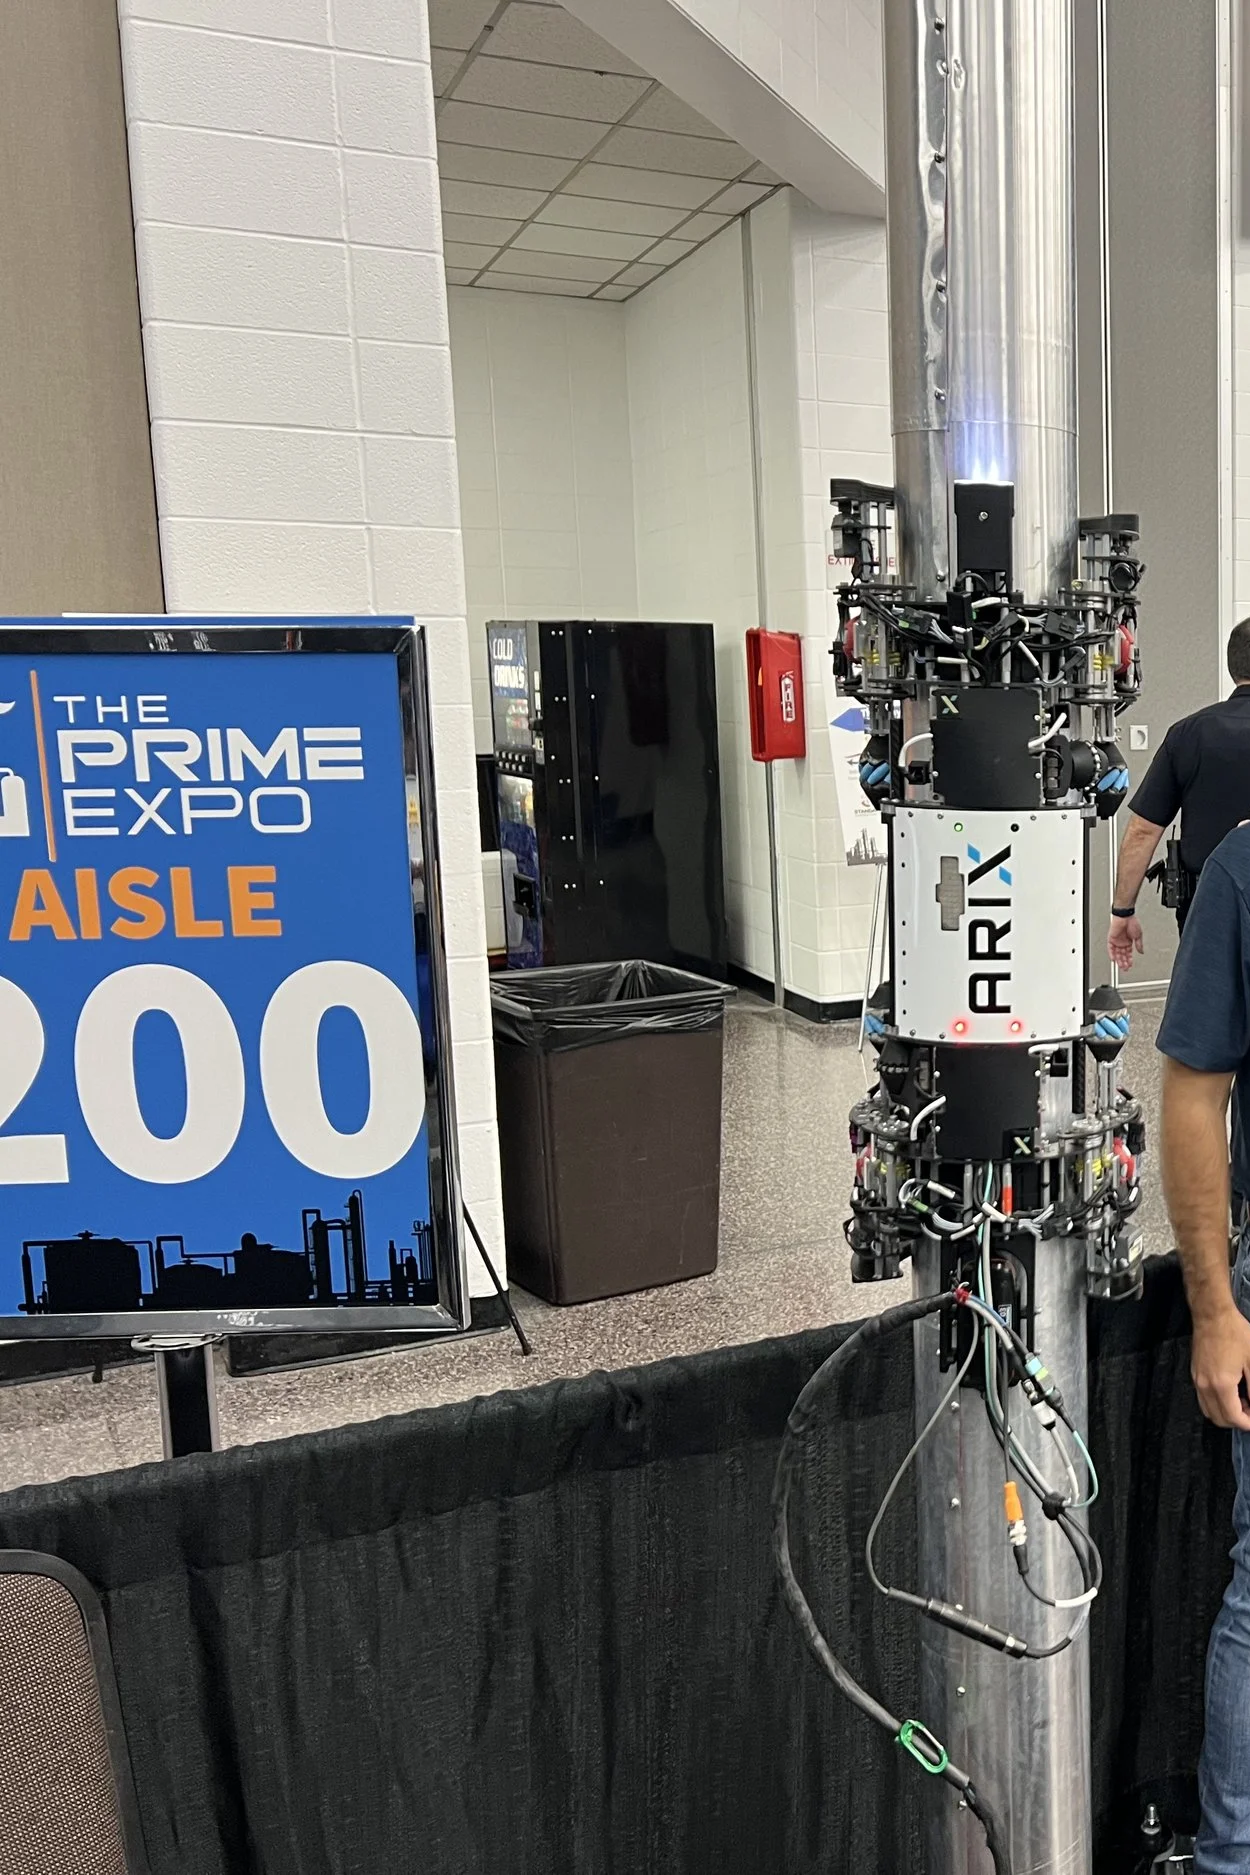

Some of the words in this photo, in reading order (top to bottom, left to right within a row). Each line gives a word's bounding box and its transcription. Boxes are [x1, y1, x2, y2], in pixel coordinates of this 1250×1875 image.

[493, 638, 513, 660] COLD
[494, 665, 525, 688] DRINKS
[53, 695, 170, 723] THE
[784, 683, 793, 718] FIRE
[57, 727, 364, 783] PRIME
[62, 786, 312, 836] EXPO
[8, 865, 283, 941] AISLE
[967, 842, 1012, 1014] ARIX
